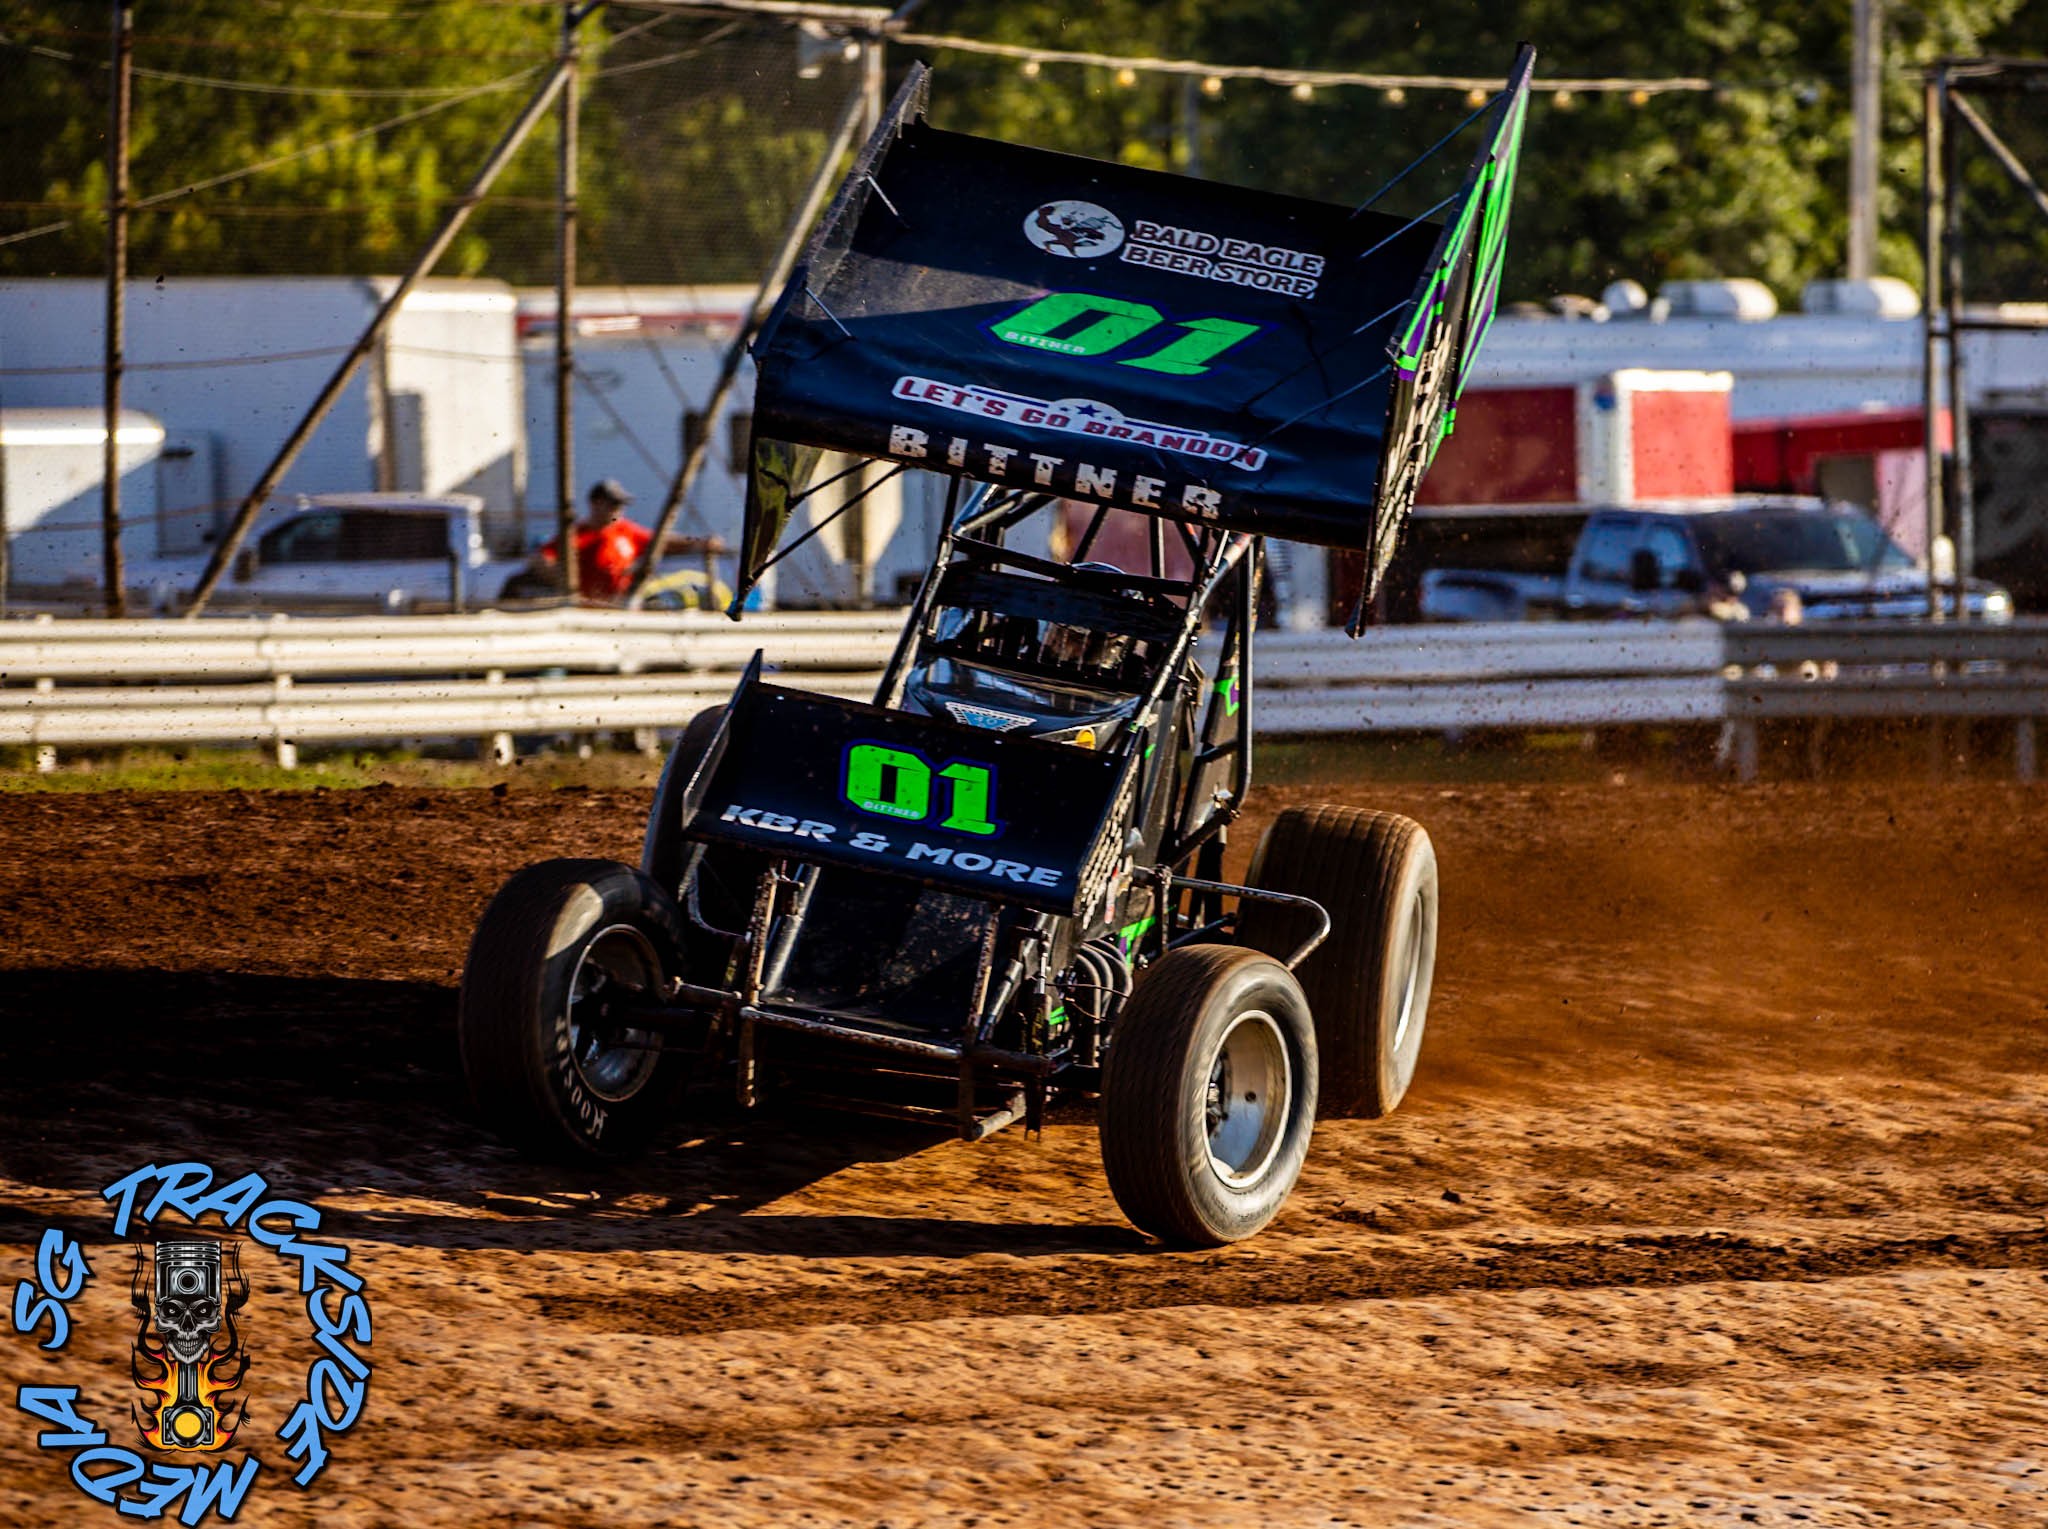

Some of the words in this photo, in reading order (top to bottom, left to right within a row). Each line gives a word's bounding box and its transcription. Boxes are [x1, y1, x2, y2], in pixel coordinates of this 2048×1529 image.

[1120, 243, 1212, 277] BEER
[1130, 220, 1220, 254] BALD
[1220, 238, 1325, 276] EAGLE
[990, 292, 1261, 375] 01
[899, 378, 1004, 416] LET'S
[1020, 407, 1069, 429] GO
[1083, 420, 1266, 468] BRANDON
[888, 424, 1221, 520] BITTNER
[846, 743, 997, 835] 01
[720, 803, 837, 843] KBR
[849, 831, 891, 853] &
[905, 842, 1064, 888] MORE
